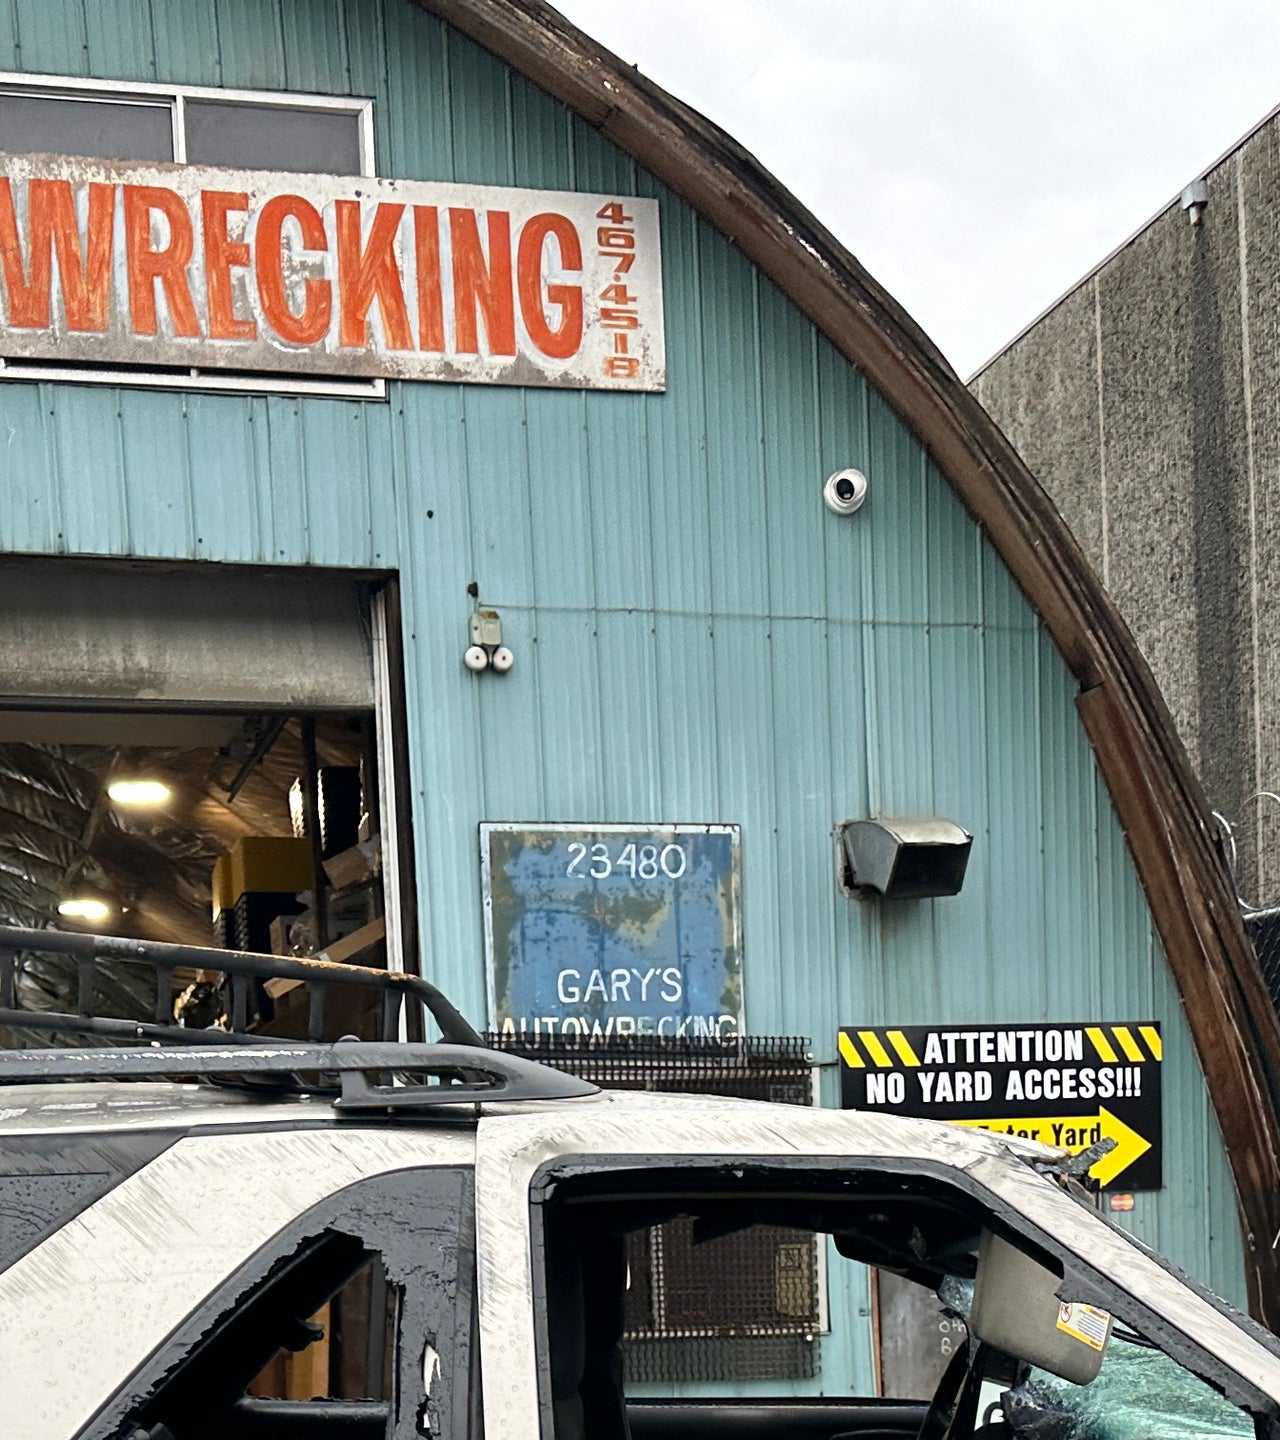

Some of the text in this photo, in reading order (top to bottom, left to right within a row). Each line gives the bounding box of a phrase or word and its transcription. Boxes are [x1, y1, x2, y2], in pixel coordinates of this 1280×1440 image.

[566, 842, 687, 880] 23480
[557, 967, 683, 1004] GARY'S
[923, 1030, 1084, 1064] ATTENTION
[866, 1067, 1142, 1105] NO YARD ACCESS!!!
[1051, 1122, 1102, 1147] Yard
